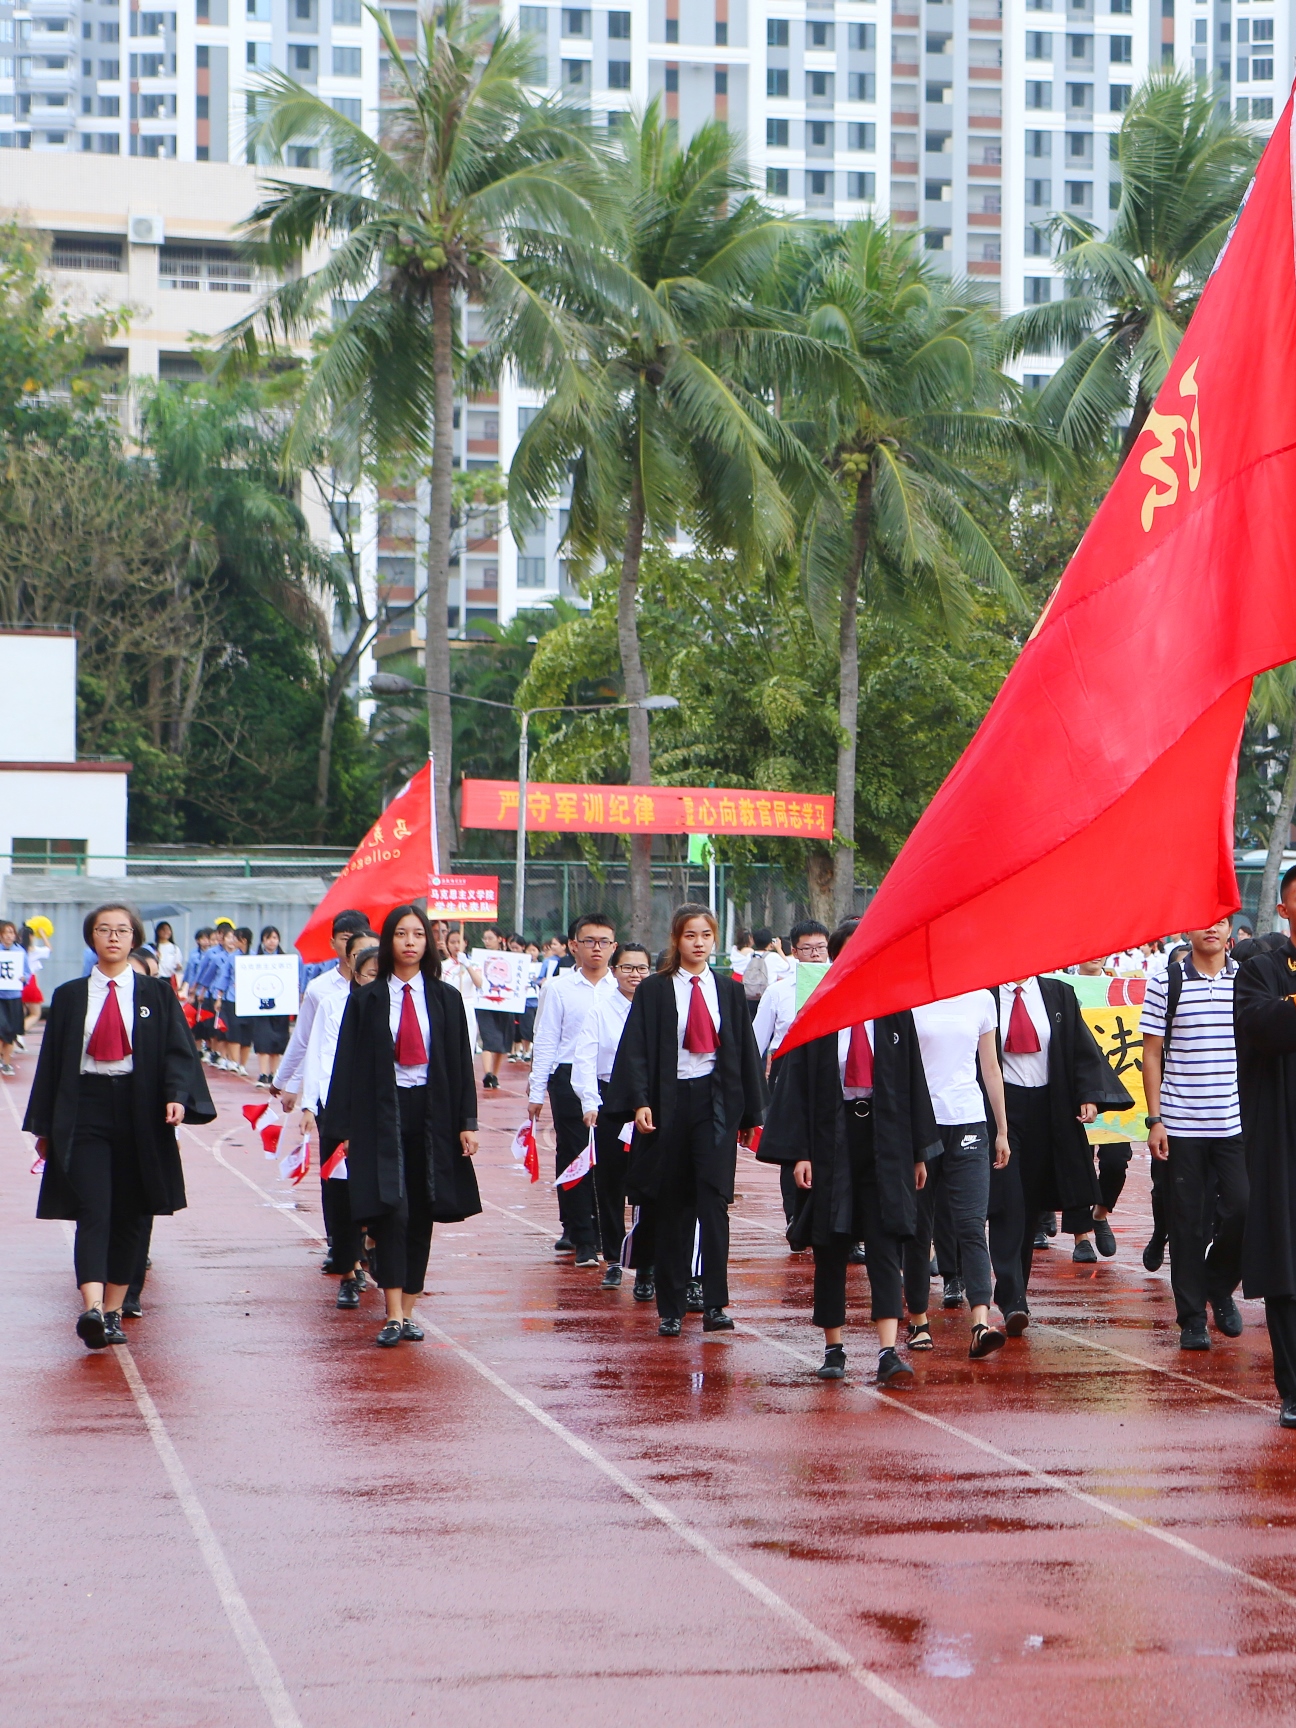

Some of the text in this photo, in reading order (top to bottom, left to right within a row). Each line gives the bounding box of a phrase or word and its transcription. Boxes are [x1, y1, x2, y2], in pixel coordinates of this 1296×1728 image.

[497, 789, 656, 826] 严守军训纪律
[430, 888, 495, 901] 马克思主义学院
[434, 900, 491, 912] 学生代表队
